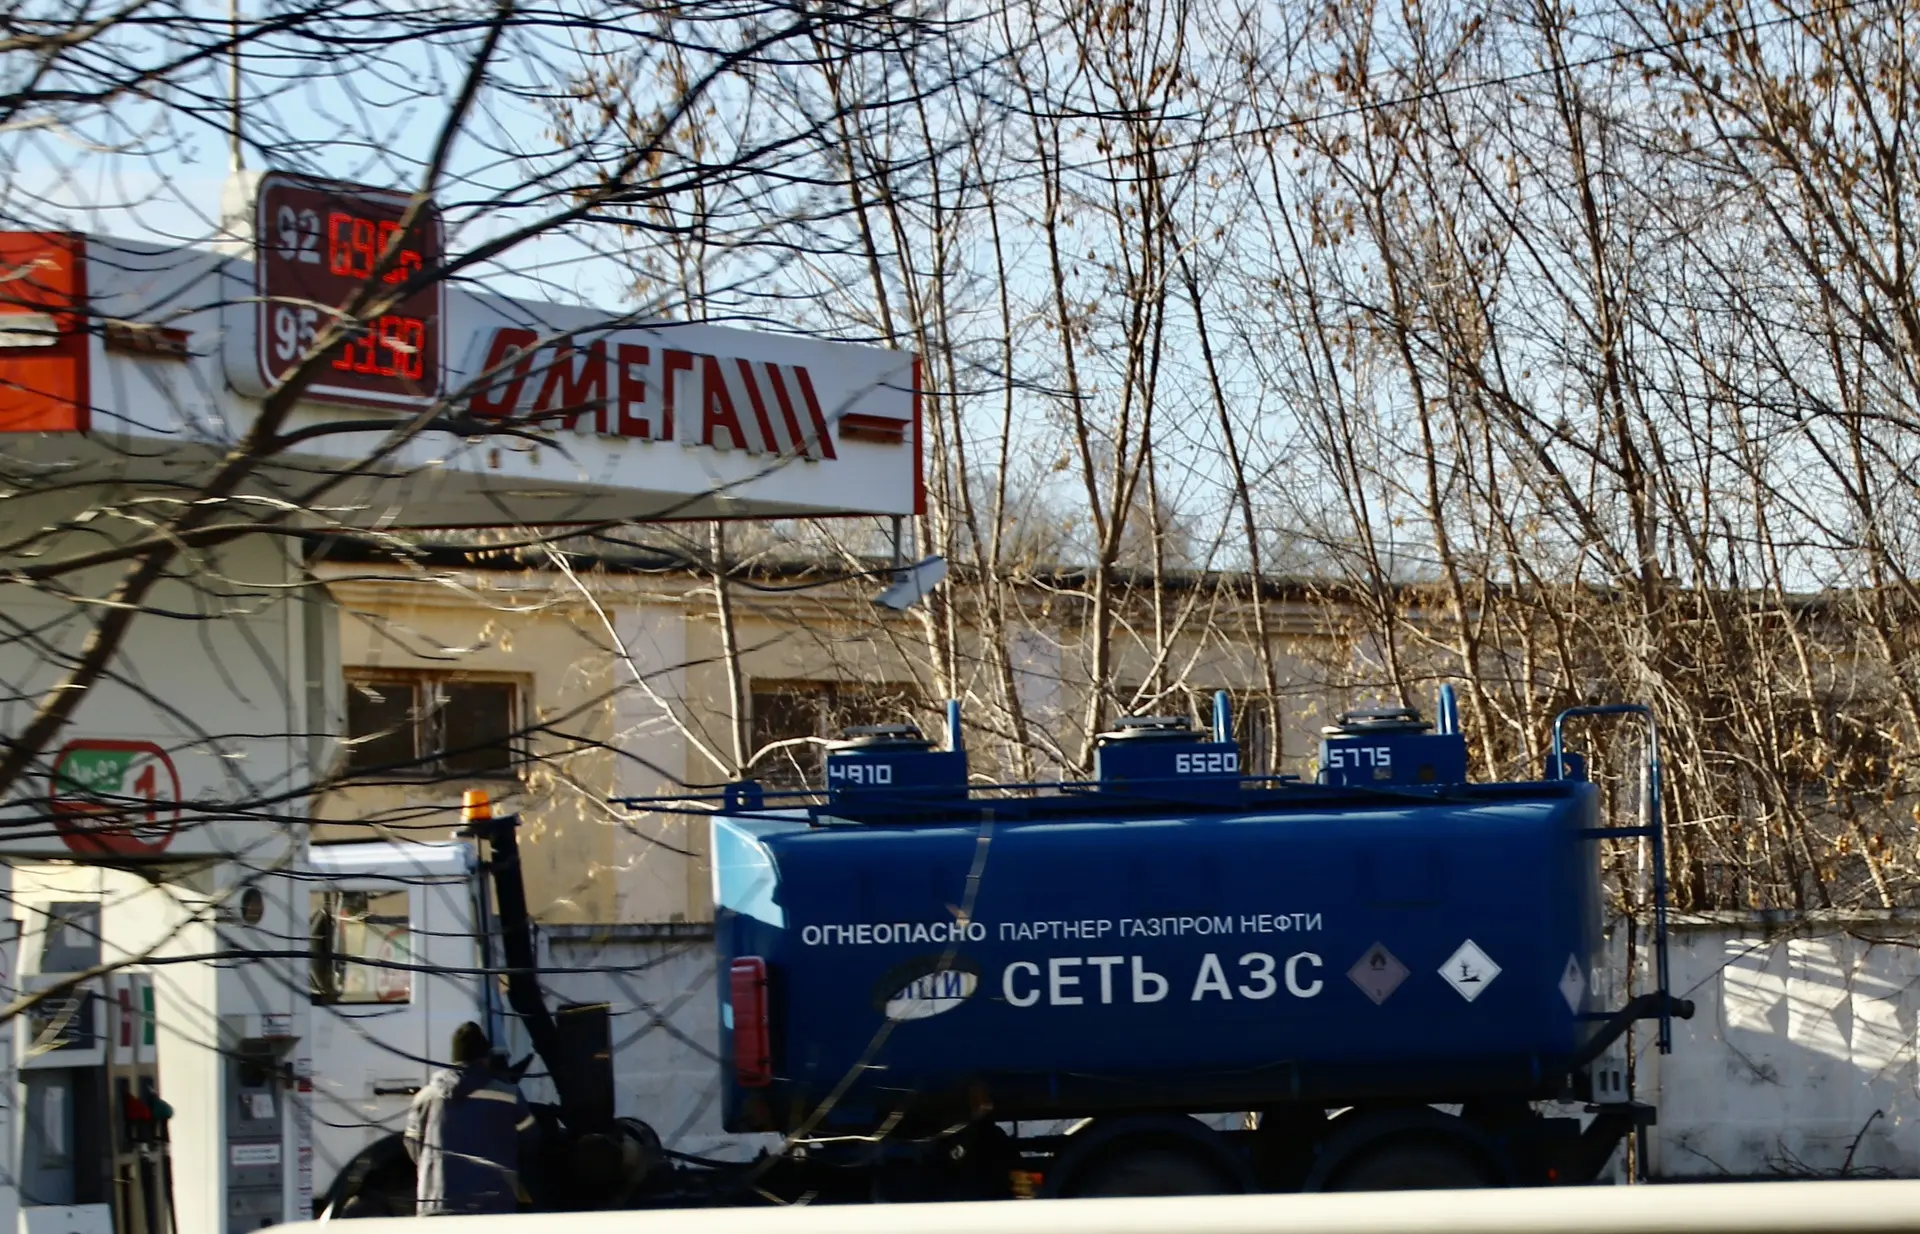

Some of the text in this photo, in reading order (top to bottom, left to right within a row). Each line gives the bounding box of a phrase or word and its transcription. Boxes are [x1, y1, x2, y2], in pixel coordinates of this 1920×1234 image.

[276, 205, 321, 264] 92
[275, 307, 318, 361] 95
[469, 327, 748, 449] ОМЕГА
[1176, 752, 1237, 773] 6520
[1329, 746, 1391, 768] 5775
[801, 912, 1323, 946] ОГНЕОПАСНО ПАРТНЕР ГАЗПРОМ НЕФТИ
[1002, 950, 1324, 1008] СЕТЬ АЗС
